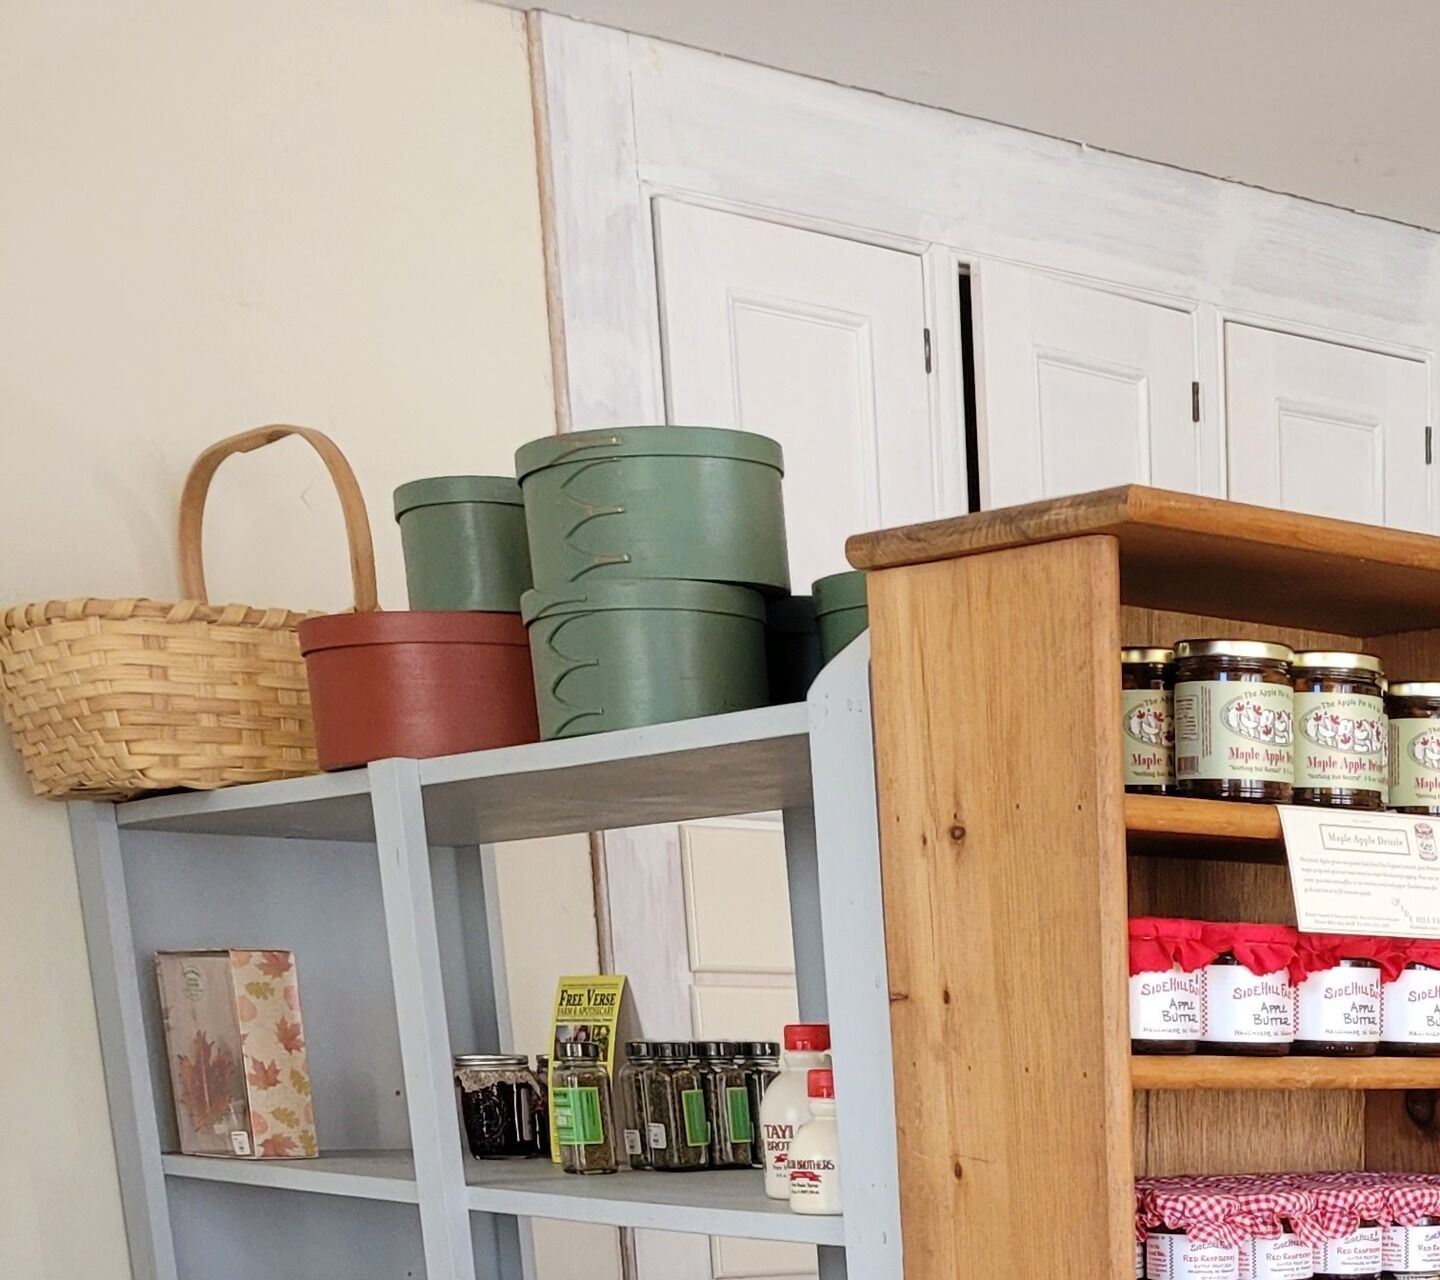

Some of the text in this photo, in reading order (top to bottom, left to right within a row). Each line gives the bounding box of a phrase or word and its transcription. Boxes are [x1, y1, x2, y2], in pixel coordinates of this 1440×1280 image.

[1131, 753, 1163, 769] Maple
[1228, 747, 1286, 767] Maple Apple
[1306, 755, 1366, 775] Maple Apple
[1327, 831, 1351, 847] Maple
[1353, 833, 1375, 847] Apple
[559, 988, 616, 1007] FREE VERSE
[1169, 998, 1195, 1010] APPLE
[1260, 1002, 1288, 1013] APPLE
[1350, 1001, 1375, 1013] APPLE
[764, 1124, 793, 1139] TAYL
[767, 1141, 791, 1151] BROT
[1266, 1253, 1281, 1261] RED
[1336, 1247, 1352, 1255] RED
[1183, 1255, 1198, 1263] RED
